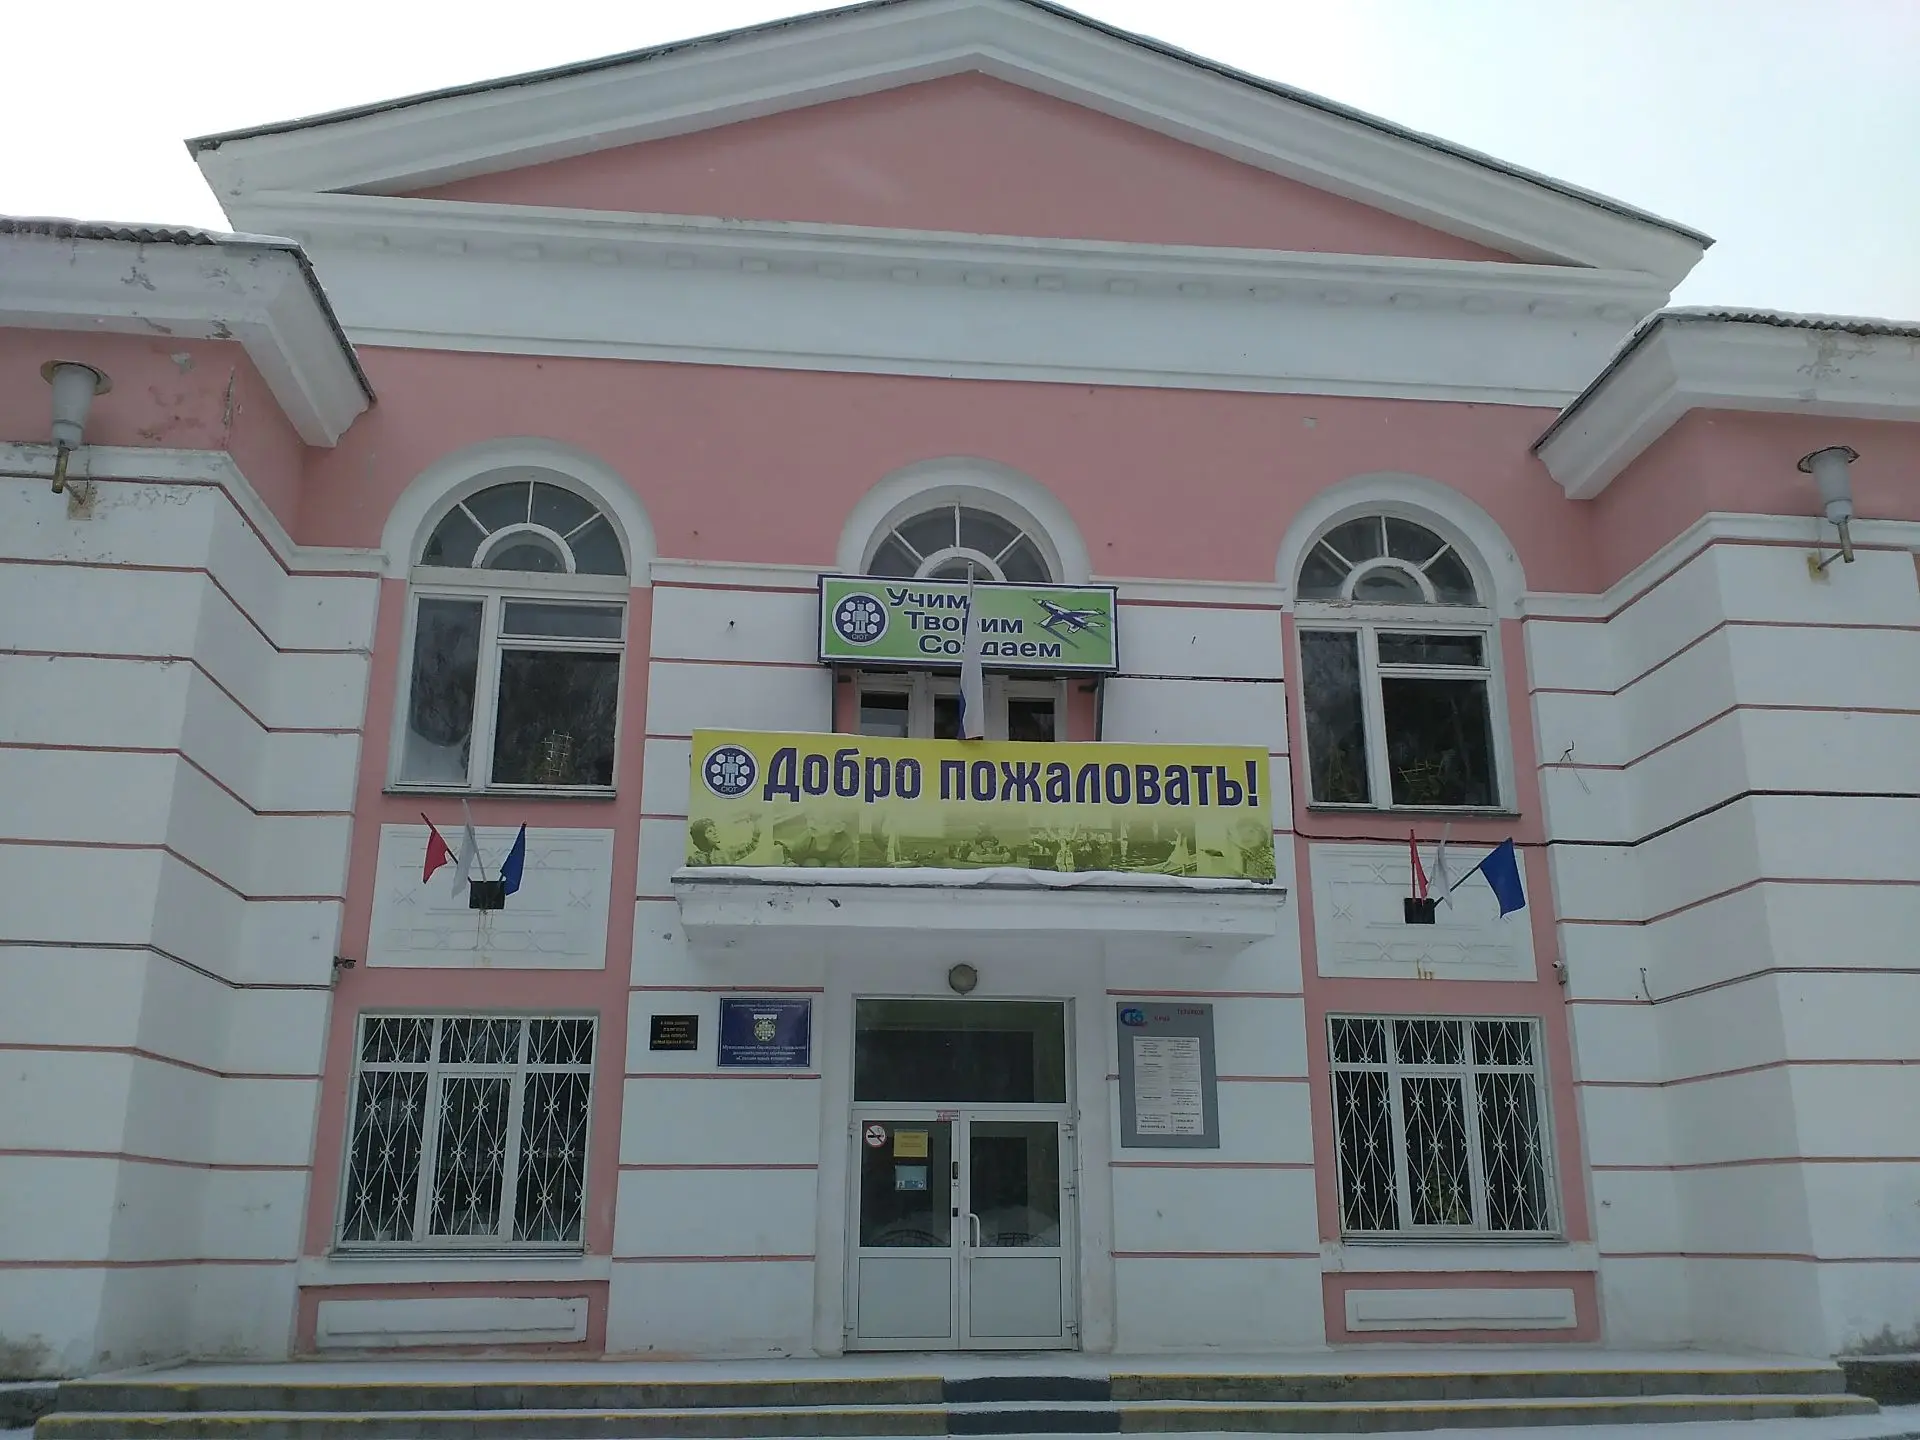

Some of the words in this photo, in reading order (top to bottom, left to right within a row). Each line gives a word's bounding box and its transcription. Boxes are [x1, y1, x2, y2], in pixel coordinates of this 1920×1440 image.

[886, 587, 969, 609] Учим
[919, 634, 1061, 657] Содаем
[762, 745, 922, 804] Добро
[940, 758, 1259, 807] пожаловать!
